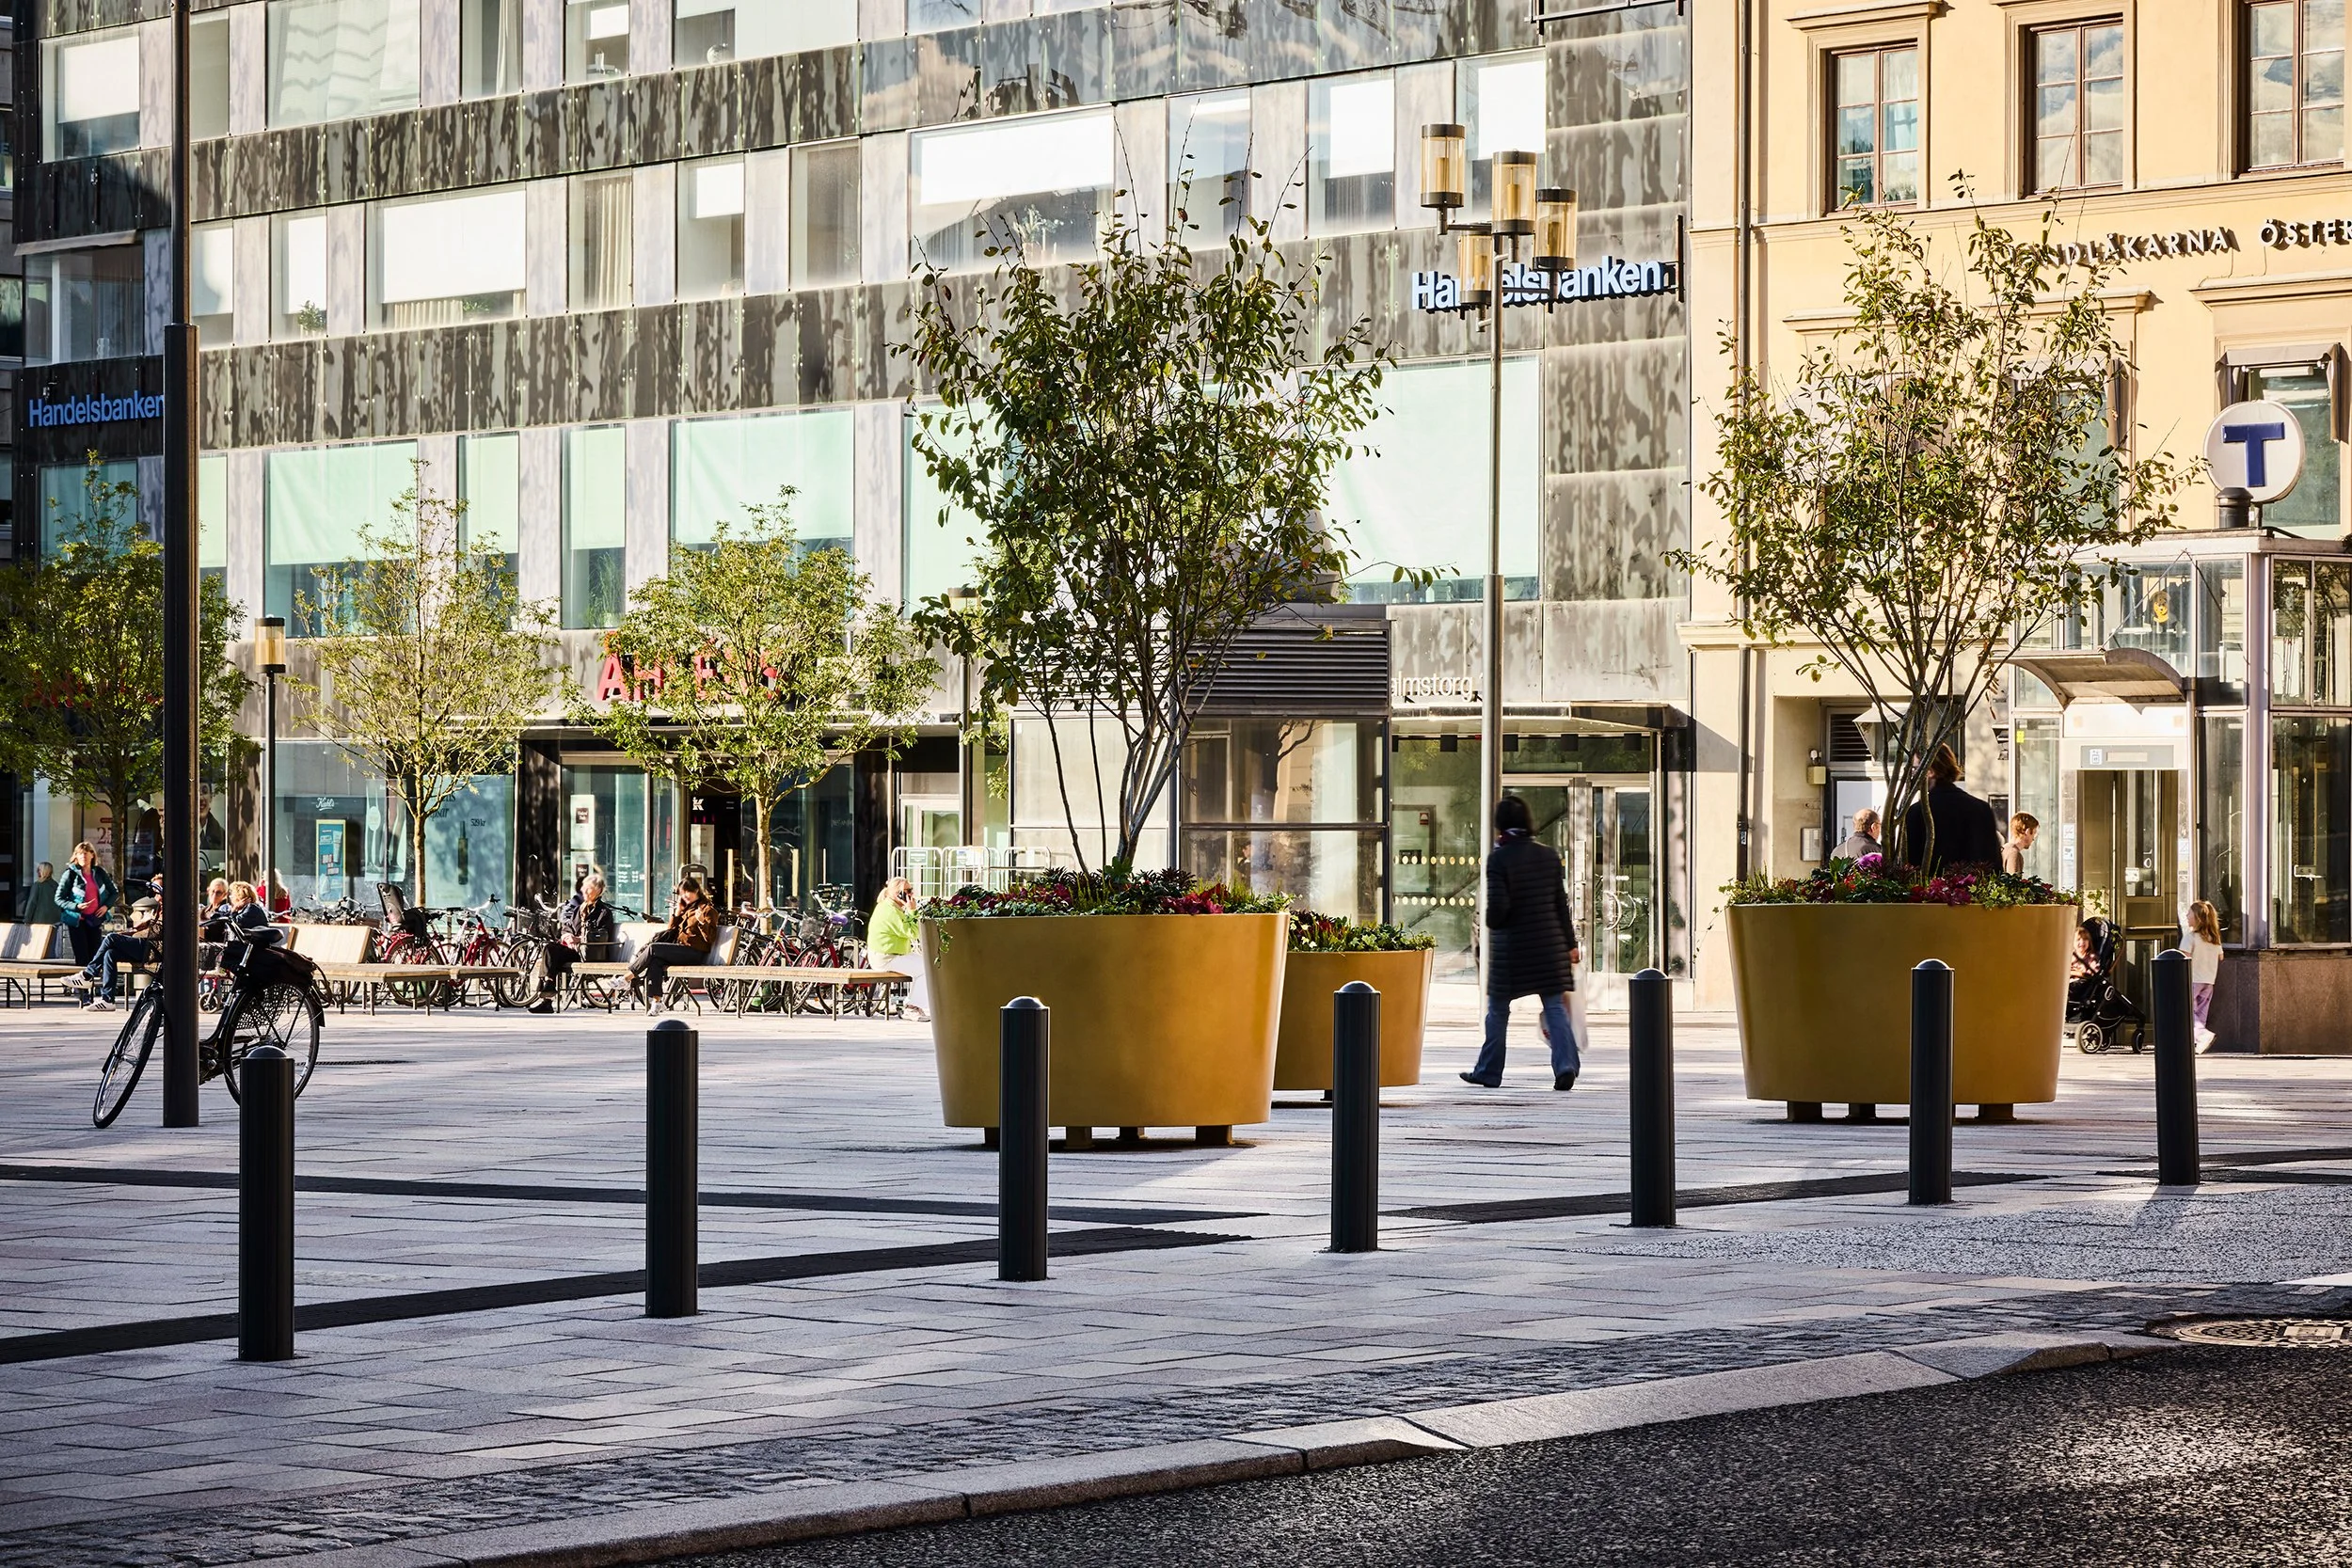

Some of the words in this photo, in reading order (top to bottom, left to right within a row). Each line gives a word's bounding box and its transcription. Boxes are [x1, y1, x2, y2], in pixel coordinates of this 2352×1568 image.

[2003, 226, 2230, 268] NDLÄKARNA
[1411, 255, 1663, 309] Haelsbanken
[29, 389, 165, 427] Handelsbanken
[2222, 421, 2285, 487] T
